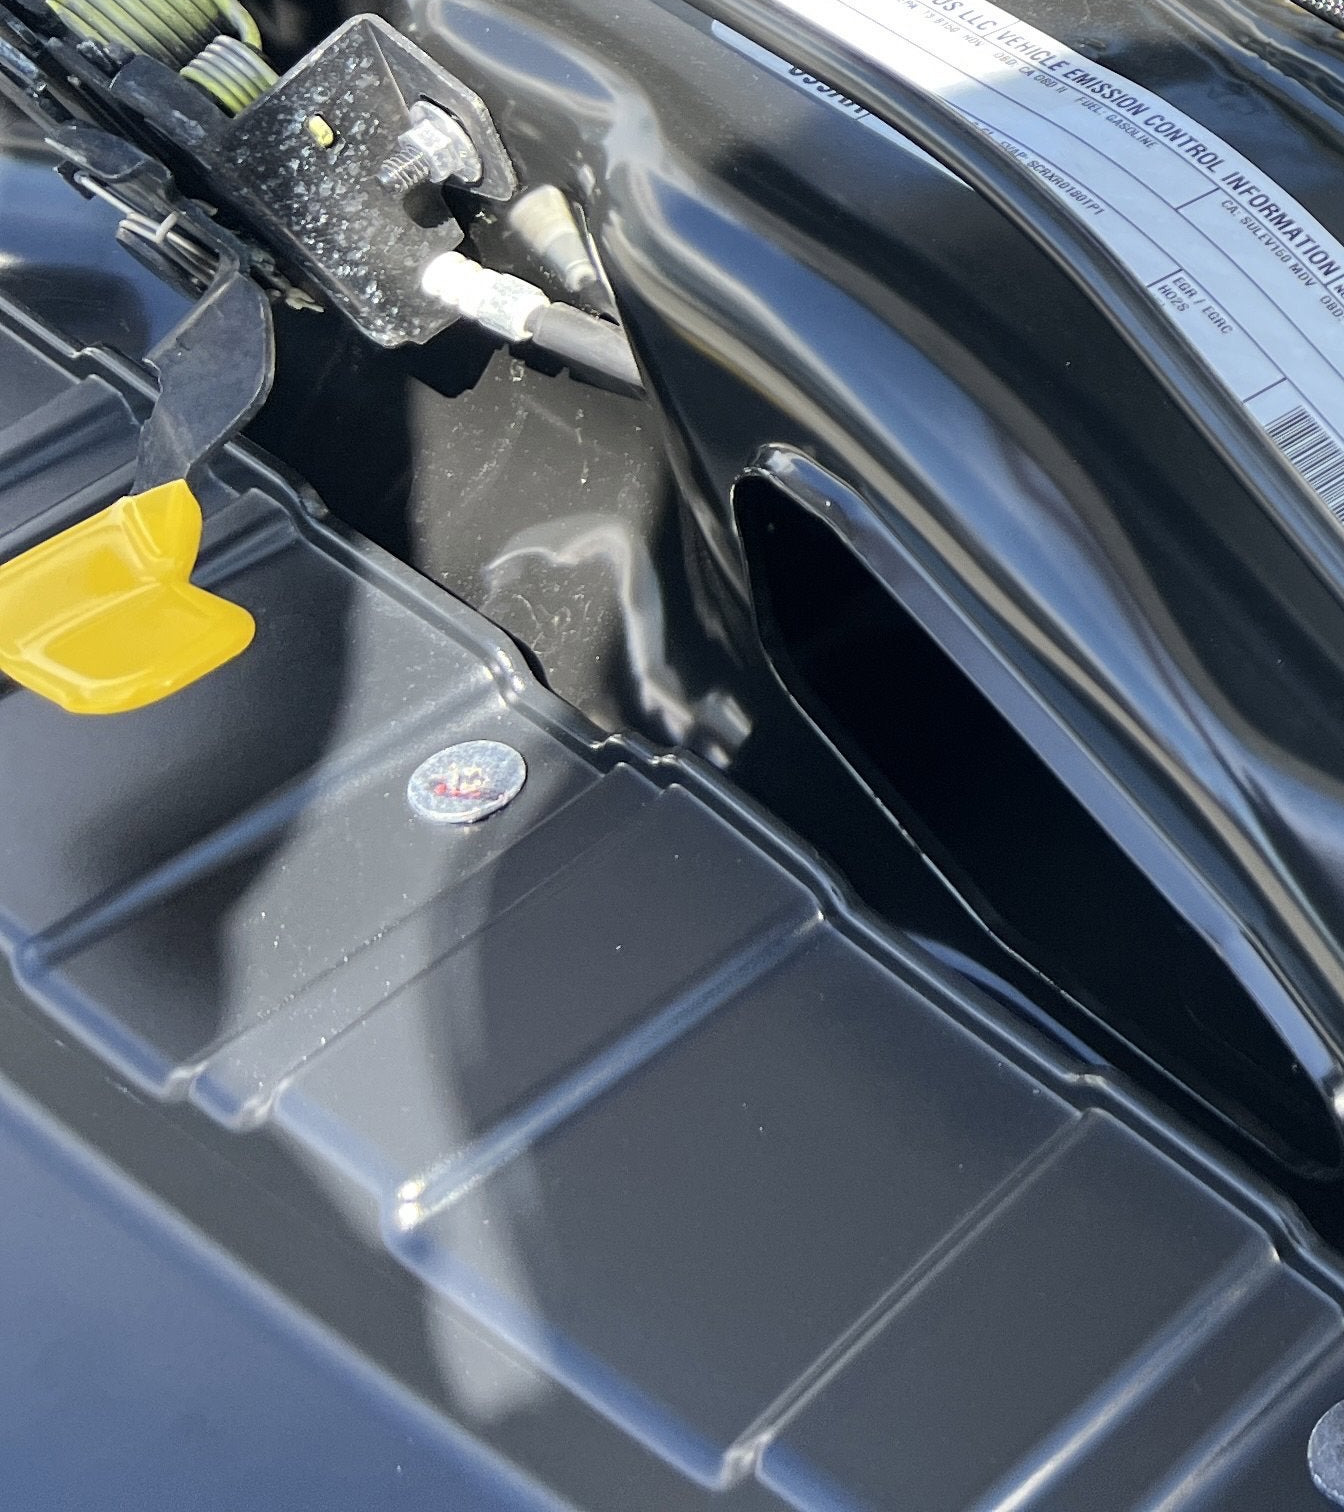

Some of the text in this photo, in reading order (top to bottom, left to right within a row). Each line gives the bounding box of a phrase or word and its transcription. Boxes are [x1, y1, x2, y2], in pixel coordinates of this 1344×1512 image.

[959, 9, 997, 31] LLC
[1018, 66, 1036, 77] CA
[1075, 96, 1160, 150] FUEL: GASOLINE
[997, 30, 1341, 277] VEHICLE EMISSION CONTROL INFORMATION
[1221, 199, 1240, 216] CA:
[1288, 263, 1317, 287] MDV
[1171, 276, 1198, 297] EGR
